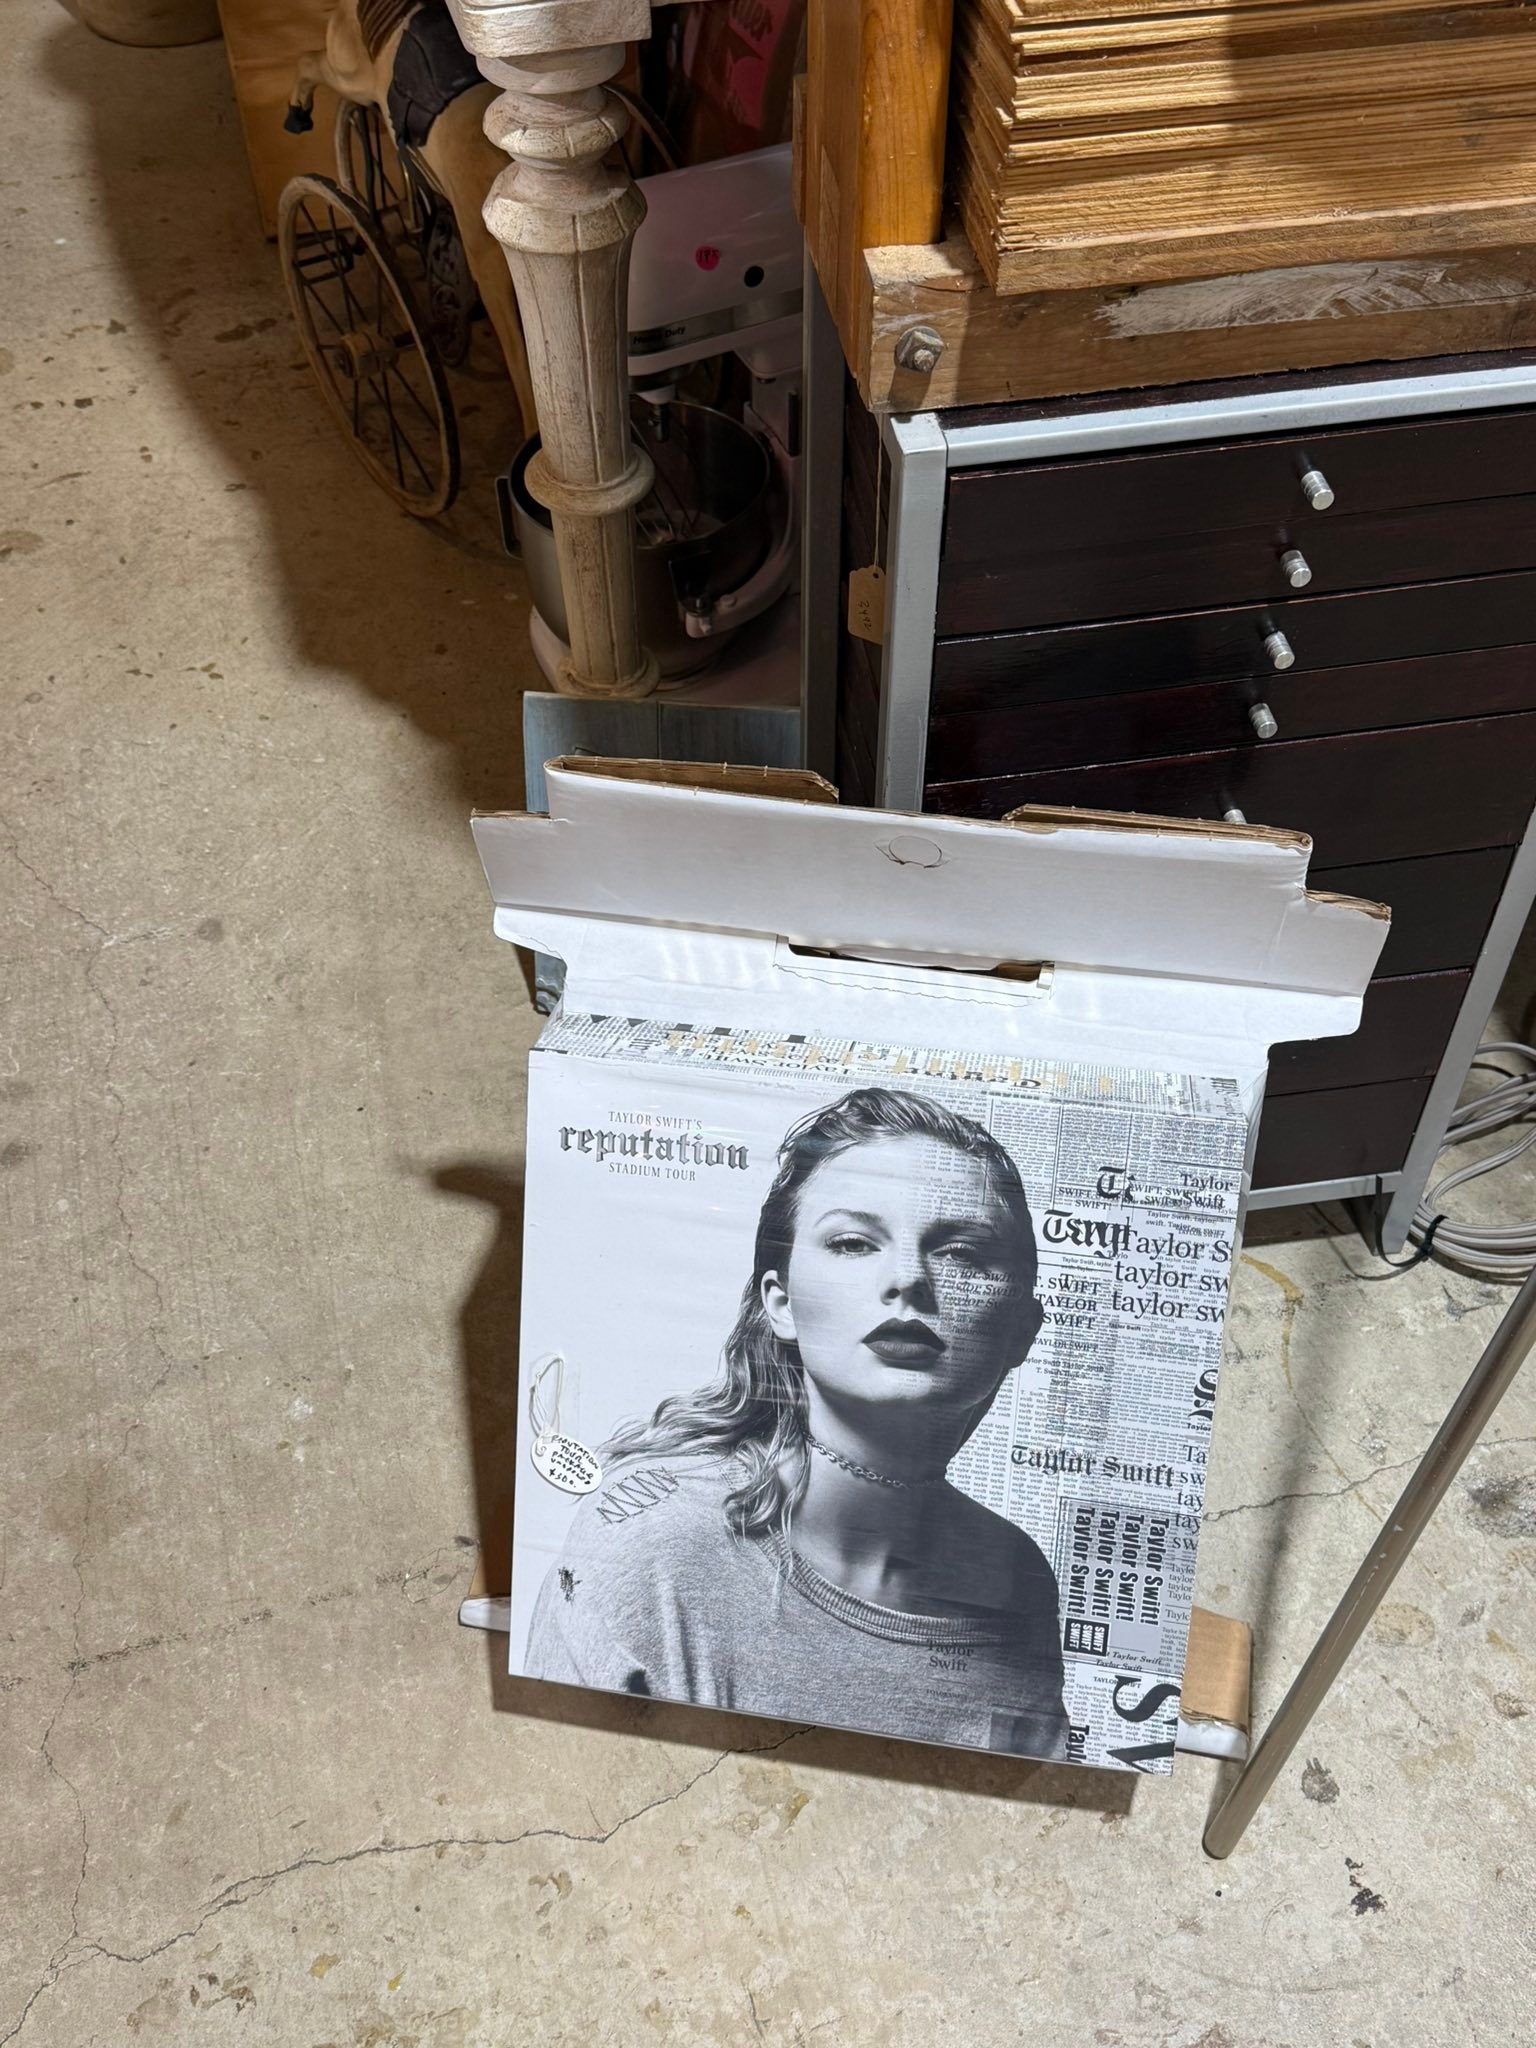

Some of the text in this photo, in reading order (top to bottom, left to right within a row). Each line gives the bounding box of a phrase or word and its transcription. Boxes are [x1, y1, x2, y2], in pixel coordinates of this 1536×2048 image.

[608, 1111, 702, 1130] TAYLOR SWIFT'S
[558, 1126, 750, 1170] reputation
[609, 1162, 696, 1181] STADIUM TOUR
[1181, 1173, 1233, 1191] Taylor
[1184, 1192, 1226, 1209] Swift
[1114, 1261, 1193, 1290] taylor
[1035, 1293, 1098, 1312] TAYLOR
[1112, 1291, 1190, 1319] taylor
[1042, 1312, 1096, 1330] SWIFT
[560, 1445, 582, 1464] TOUR
[1011, 1445, 1174, 1487] Taylor Swift
[1067, 1507, 1095, 1615] Taylor Swift!
[1091, 1510, 1120, 1618] Taylor Swift!
[1115, 1514, 1145, 1622] Taylor Swift!
[1140, 1518, 1169, 1626] Taylor Swift!
[927, 1639, 974, 1657] Taylor
[929, 1655, 968, 1672] Swift
[1112, 1651, 1137, 1661] Taylor
[1141, 1655, 1162, 1665] Swift
[1122, 1663, 1143, 1672] Swift
[1066, 1725, 1089, 1763] Tayl
